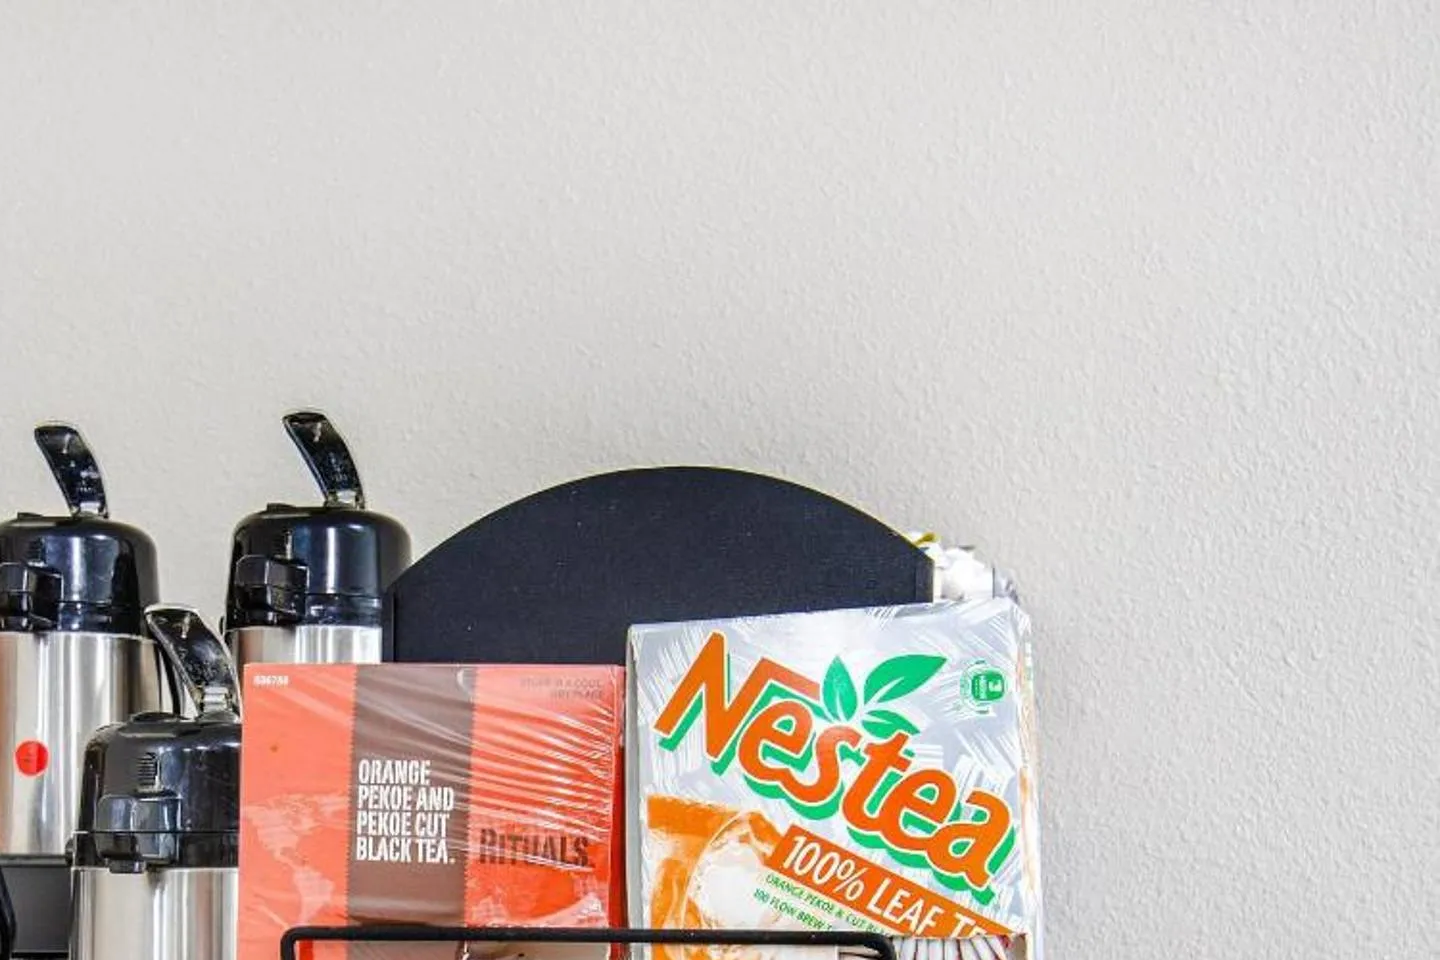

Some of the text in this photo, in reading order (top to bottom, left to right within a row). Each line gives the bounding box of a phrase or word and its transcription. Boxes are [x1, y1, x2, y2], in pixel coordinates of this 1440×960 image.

[357, 758, 432, 786] ORANGE
[654, 631, 1014, 895] Nestea
[357, 784, 456, 812] PEKOE AND
[356, 810, 451, 838] PEKOE CUT
[355, 836, 457, 865] BLACK TEA.
[765, 873, 804, 900] ORANGE
[783, 836, 864, 901] 100%
[866, 878, 943, 935] LEAF
